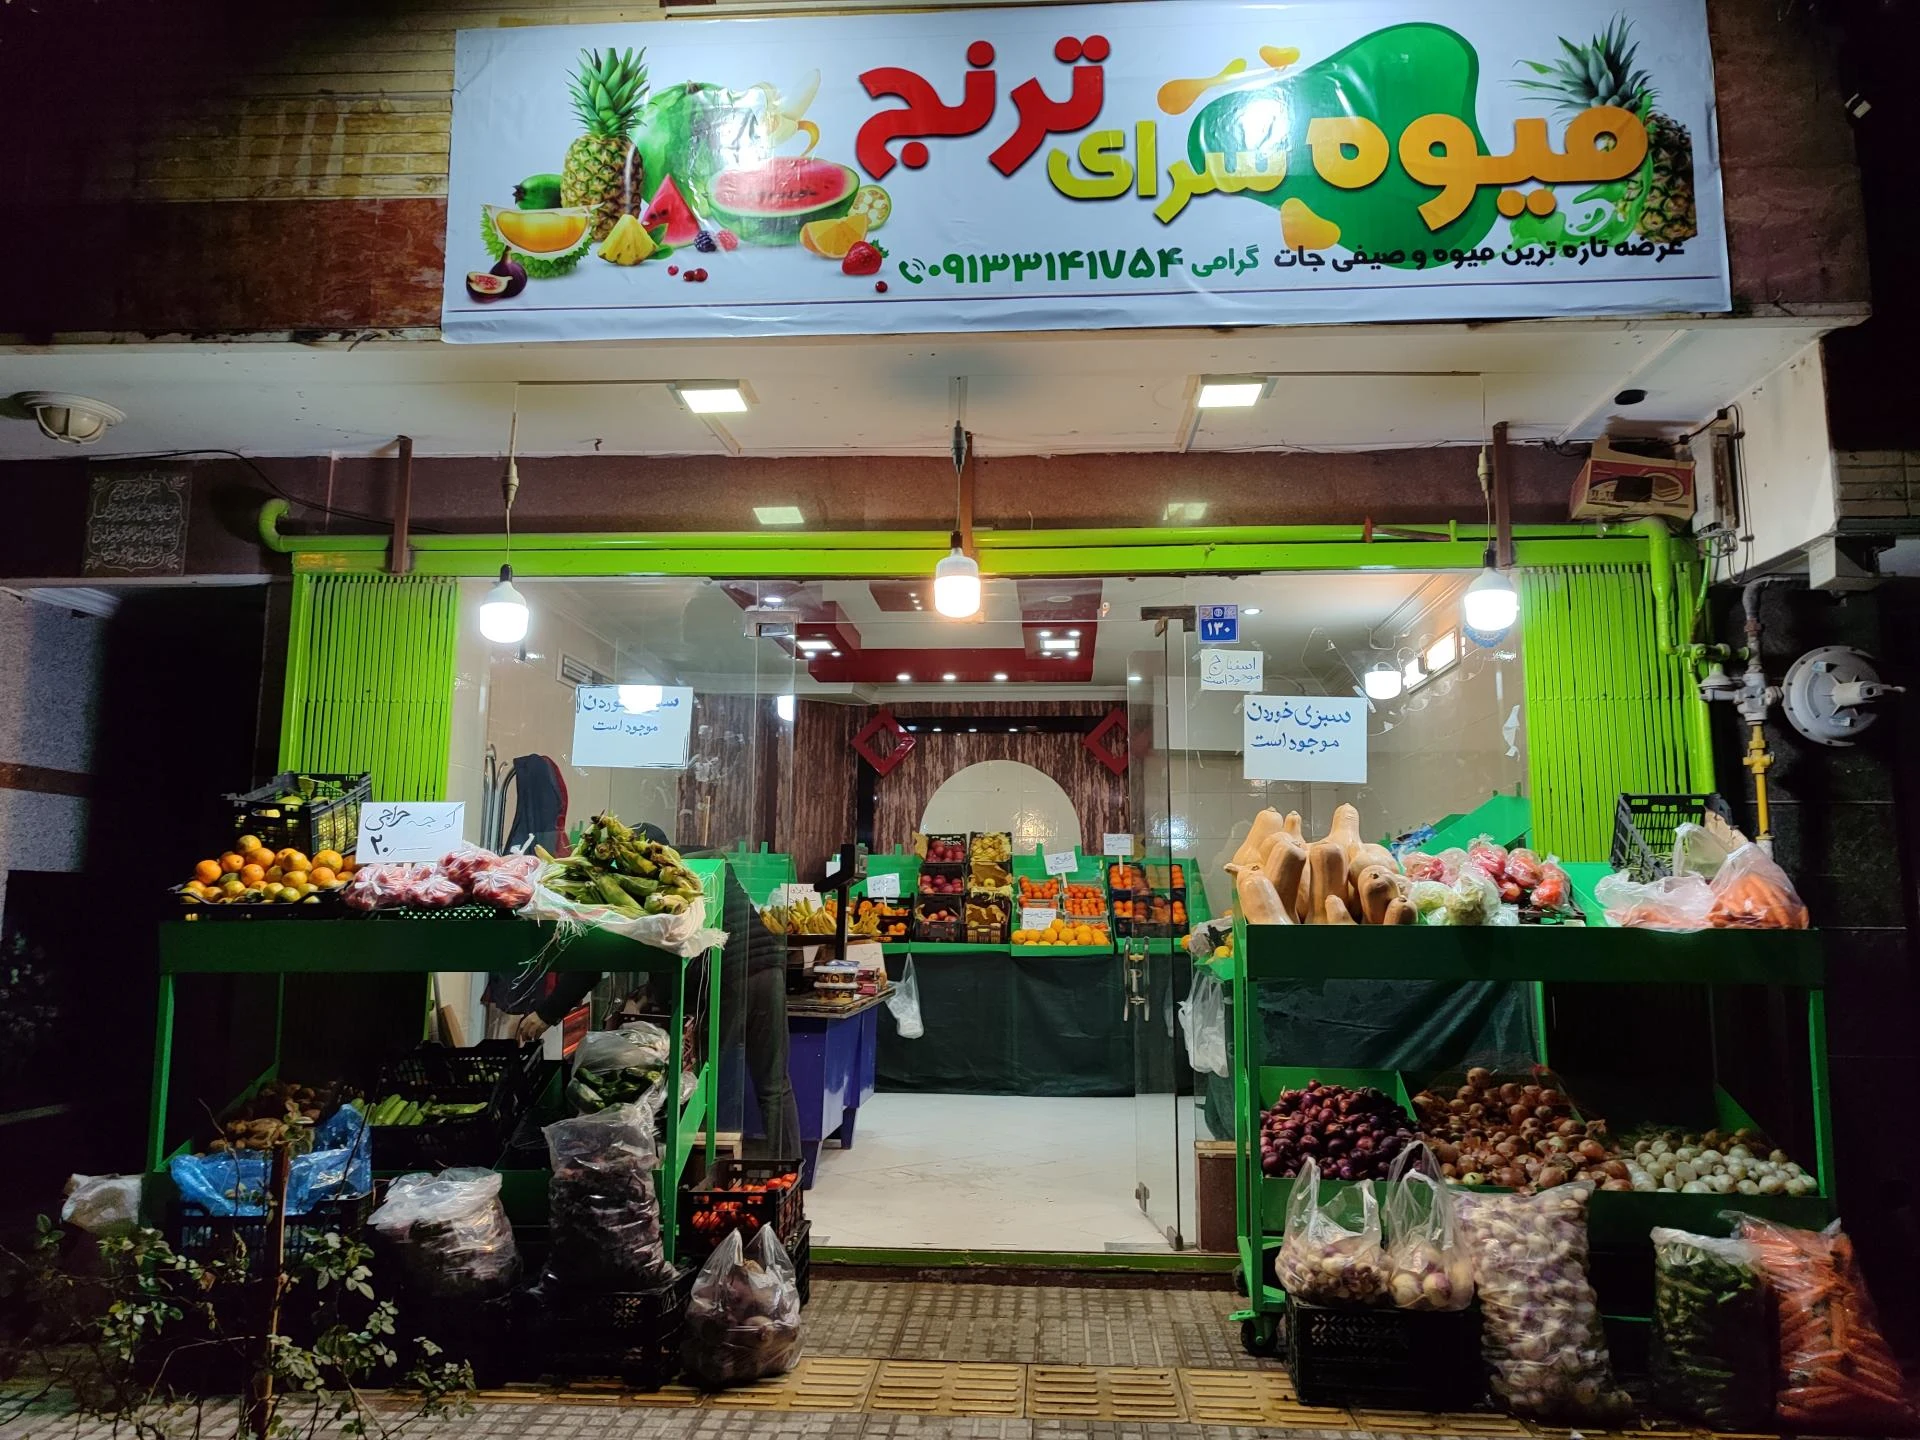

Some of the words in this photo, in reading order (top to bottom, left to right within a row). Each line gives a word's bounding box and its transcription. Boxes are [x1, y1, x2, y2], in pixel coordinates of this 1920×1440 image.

[856, 35, 1110, 180] ترنج
[1047, 121, 1287, 224] سرای
[1305, 105, 1649, 231] میوه
[1191, 244, 1259, 277] گرامی
[1274, 245, 1326, 272] جات
[1332, 244, 1406, 272] صیفی
[1412, 248, 1428, 270] و
[1432, 247, 1494, 269] میوه
[1501, 241, 1556, 267] ترین
[1562, 236, 1608, 265] تازه
[1614, 236, 1685, 263] عرضه
[928, 247, 1183, 283] ۰۹۱۳۳۱۴۱۷۵۴
[1207, 622, 1230, 636] ۱۳۰
[1208, 654, 1256, 676] اسفناج
[582, 694, 625, 712] وردن
[1246, 701, 1293, 724] خوردن
[592, 720, 622, 731] است
[1295, 704, 1351, 729] سبزی
[625, 724, 658, 736] موجود
[1250, 732, 1286, 748] است
[1289, 734, 1339, 755] موجود
